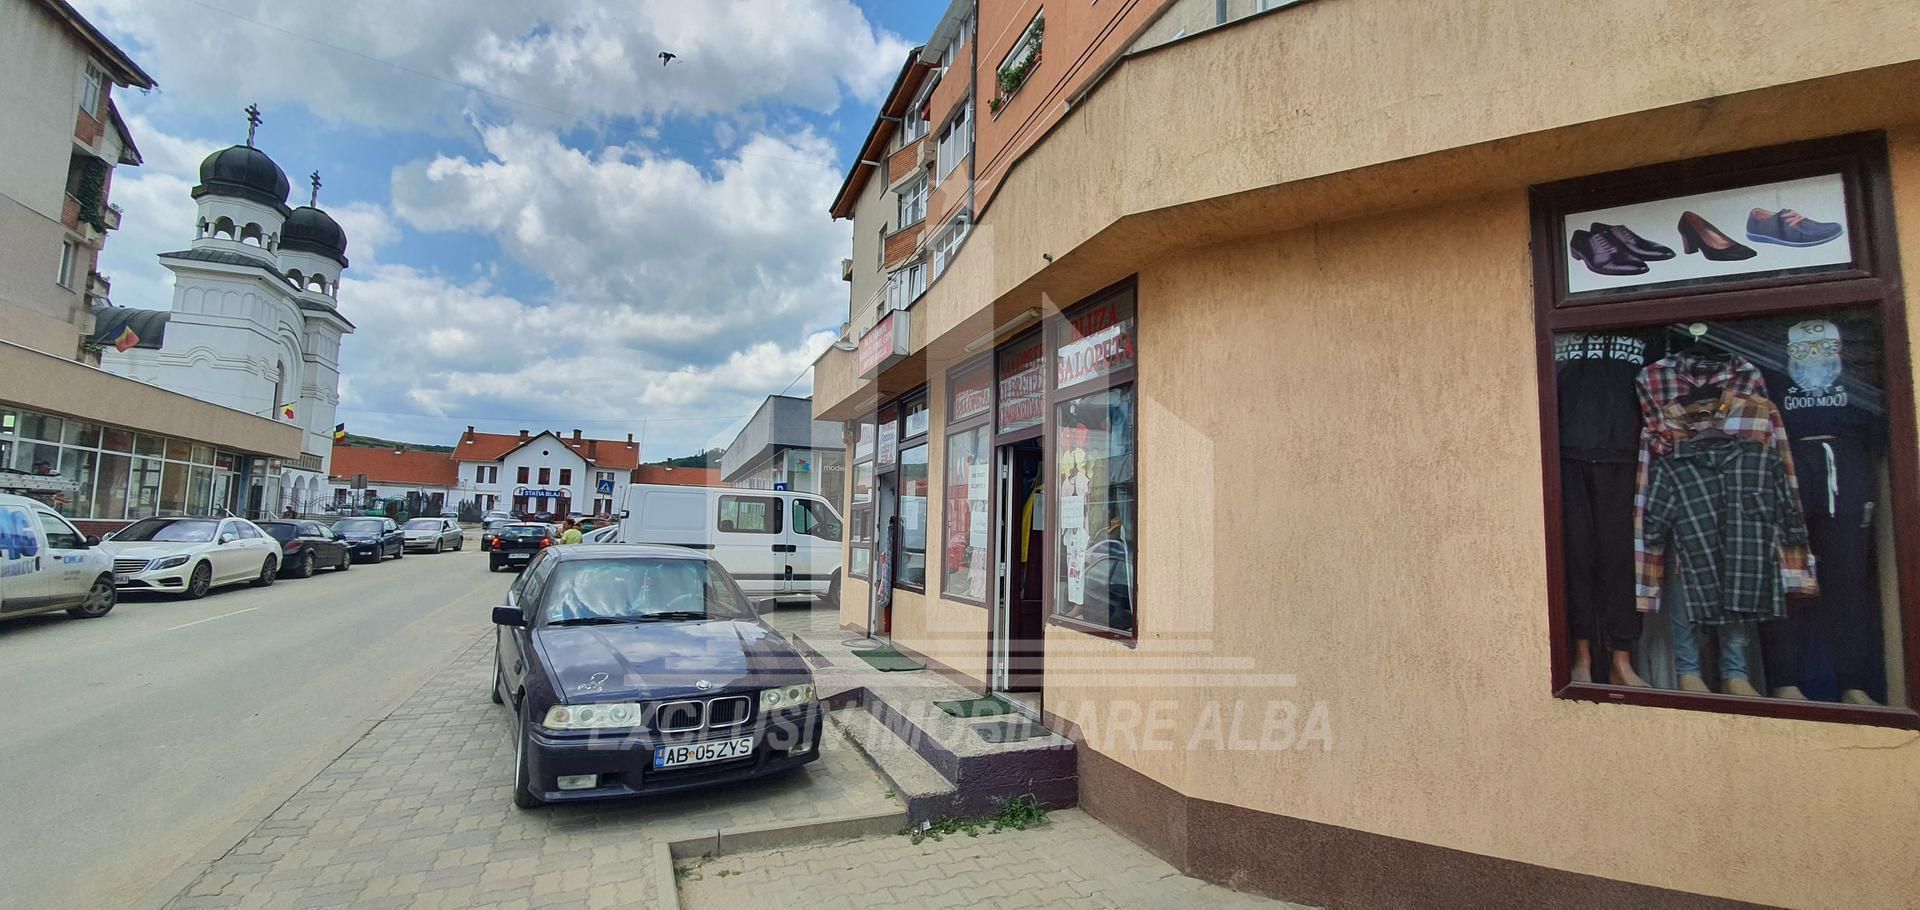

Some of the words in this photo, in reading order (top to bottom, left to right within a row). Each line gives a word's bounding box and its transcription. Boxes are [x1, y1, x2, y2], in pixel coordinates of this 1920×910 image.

[1057, 334, 1135, 384] SALOPETA
[1784, 396, 1815, 410] GOOD
[1816, 392, 1847, 407] MOOD
[666, 747, 689, 764] AB
[696, 744, 715, 760] 05
[716, 739, 750, 758] ZYS
